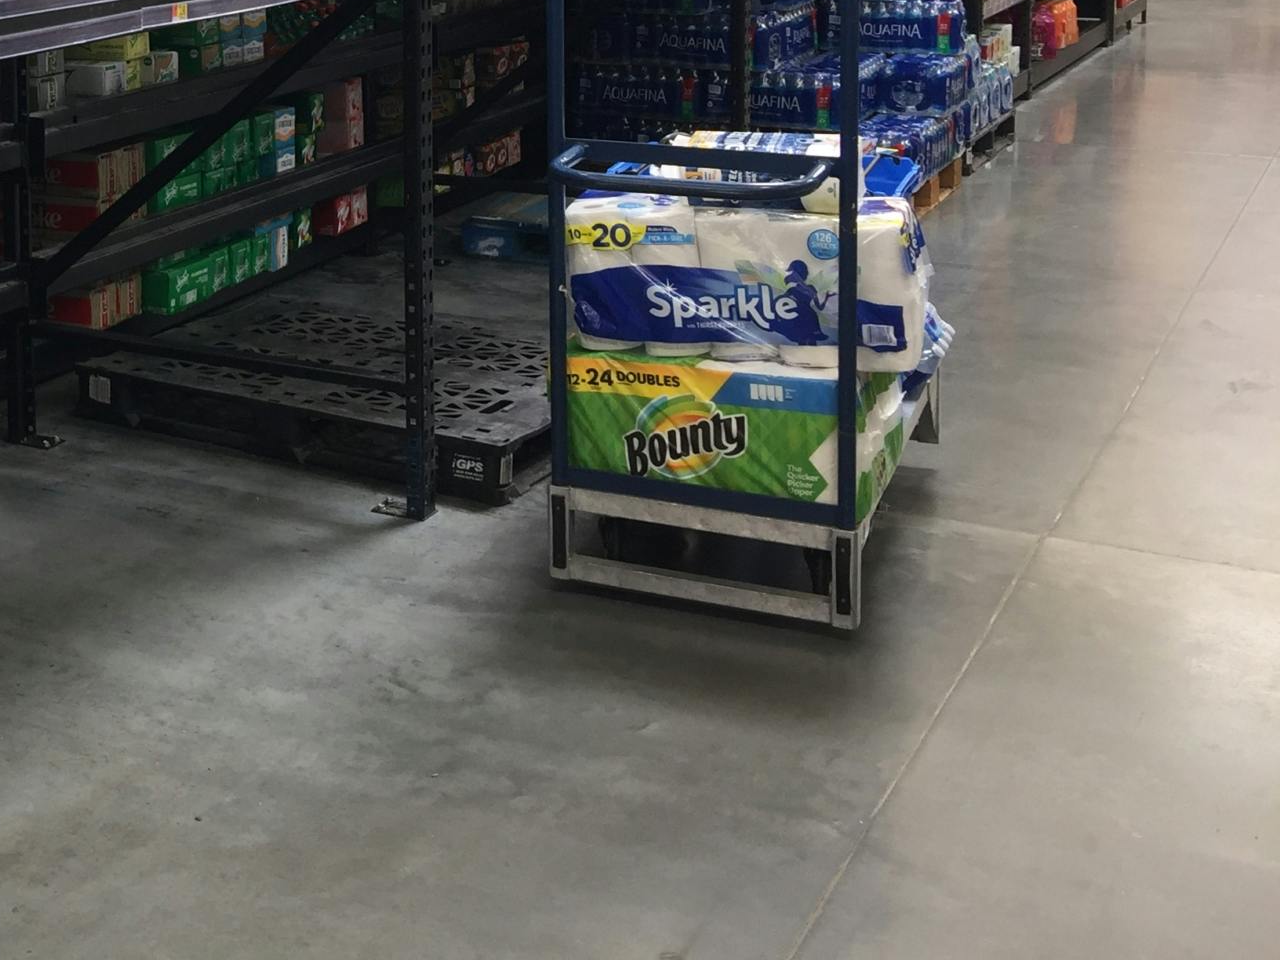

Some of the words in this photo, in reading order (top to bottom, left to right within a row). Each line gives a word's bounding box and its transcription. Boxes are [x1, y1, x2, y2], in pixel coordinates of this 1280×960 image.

[657, 31, 727, 55] AQUAFINA
[601, 85, 668, 105] AQUAFINA
[749, 95, 802, 113] UAFINA
[567, 228, 581, 241] 10
[591, 223, 631, 248] 20
[815, 233, 832, 243] 126
[646, 282, 799, 329] Sparkle
[616, 370, 680, 388] DOUBLES
[624, 412, 746, 477] Bounty
[786, 471, 819, 483] Quicker
[787, 464, 803, 473] The
[786, 479, 813, 490] Picker
